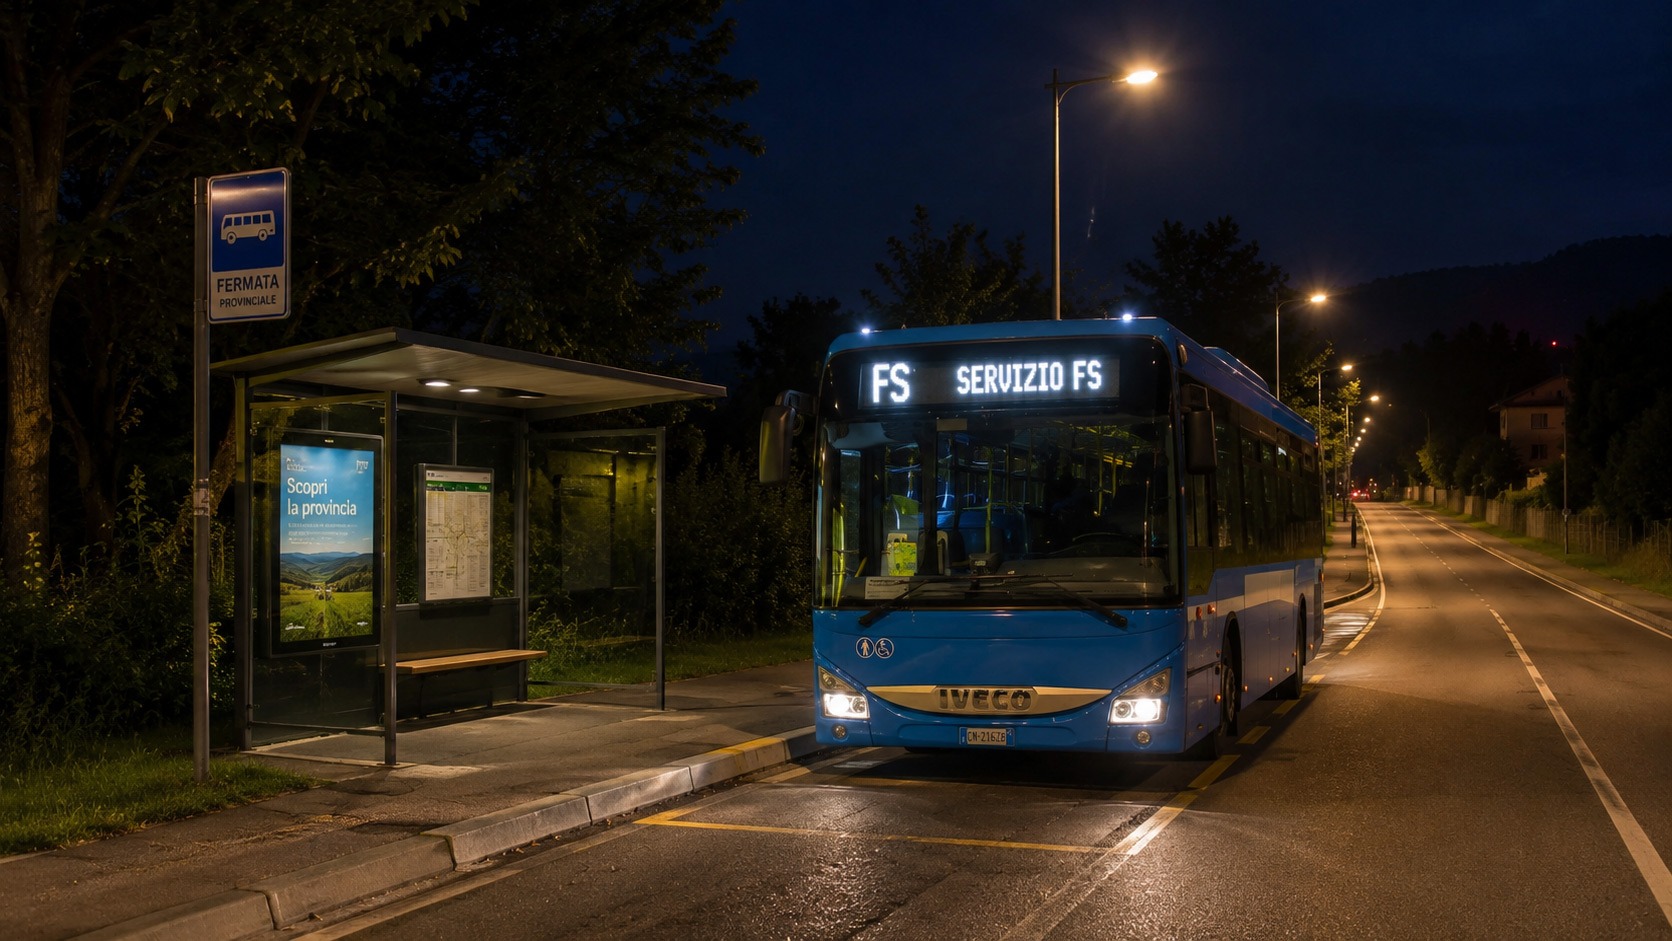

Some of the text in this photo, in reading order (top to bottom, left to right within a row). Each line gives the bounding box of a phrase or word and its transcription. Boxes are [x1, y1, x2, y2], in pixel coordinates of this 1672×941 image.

[217, 274, 279, 292] FERMATA
[220, 295, 276, 308] PROVINCIALE
[872, 362, 910, 403] FS
[956, 360, 1102, 394] SERVIZIO FS
[287, 477, 328, 498] Scopri
[287, 498, 356, 519] la provincia
[940, 689, 1031, 710] IVECO
